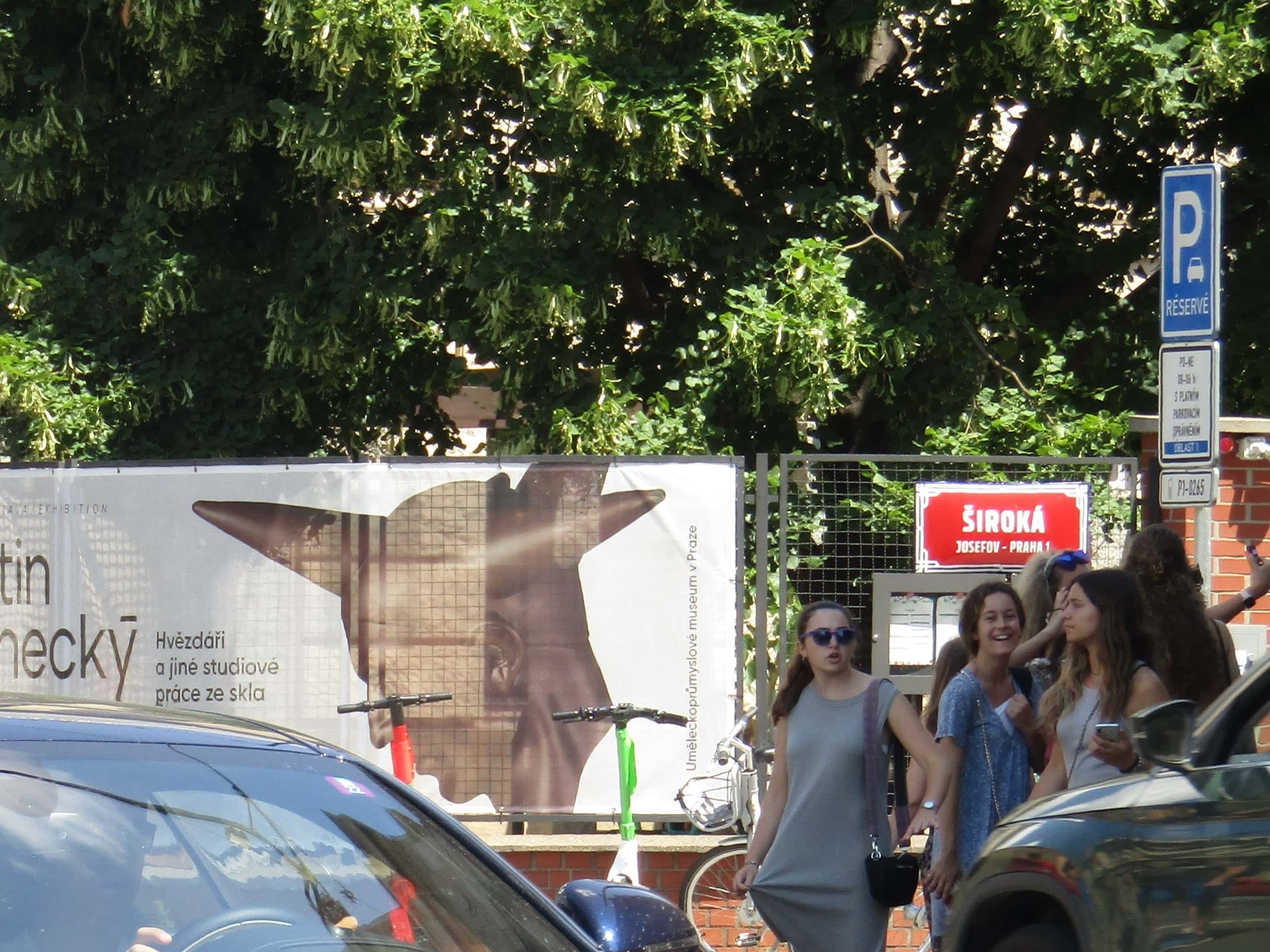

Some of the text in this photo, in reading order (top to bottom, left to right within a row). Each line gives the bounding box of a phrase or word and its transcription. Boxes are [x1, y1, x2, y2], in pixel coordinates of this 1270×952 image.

[1173, 190, 1203, 284] P
[1166, 292, 1209, 316] RÉSERVÉ
[1174, 442, 1194, 453] OBLAST
[1177, 479, 1205, 496] P1-0265
[962, 504, 1046, 534] ŠIROKÁ
[955, 540, 1001, 554] JOSEFOV
[1009, 540, 1043, 554] PRAHA
[1045, 540, 1050, 553] 1
[156, 631, 225, 649] Hvězdáři
[685, 524, 700, 772] Uměleckoprůmyslové museum v Praze
[155, 656, 279, 680] a jiné studiové
[155, 682, 265, 706] práce ze skla
